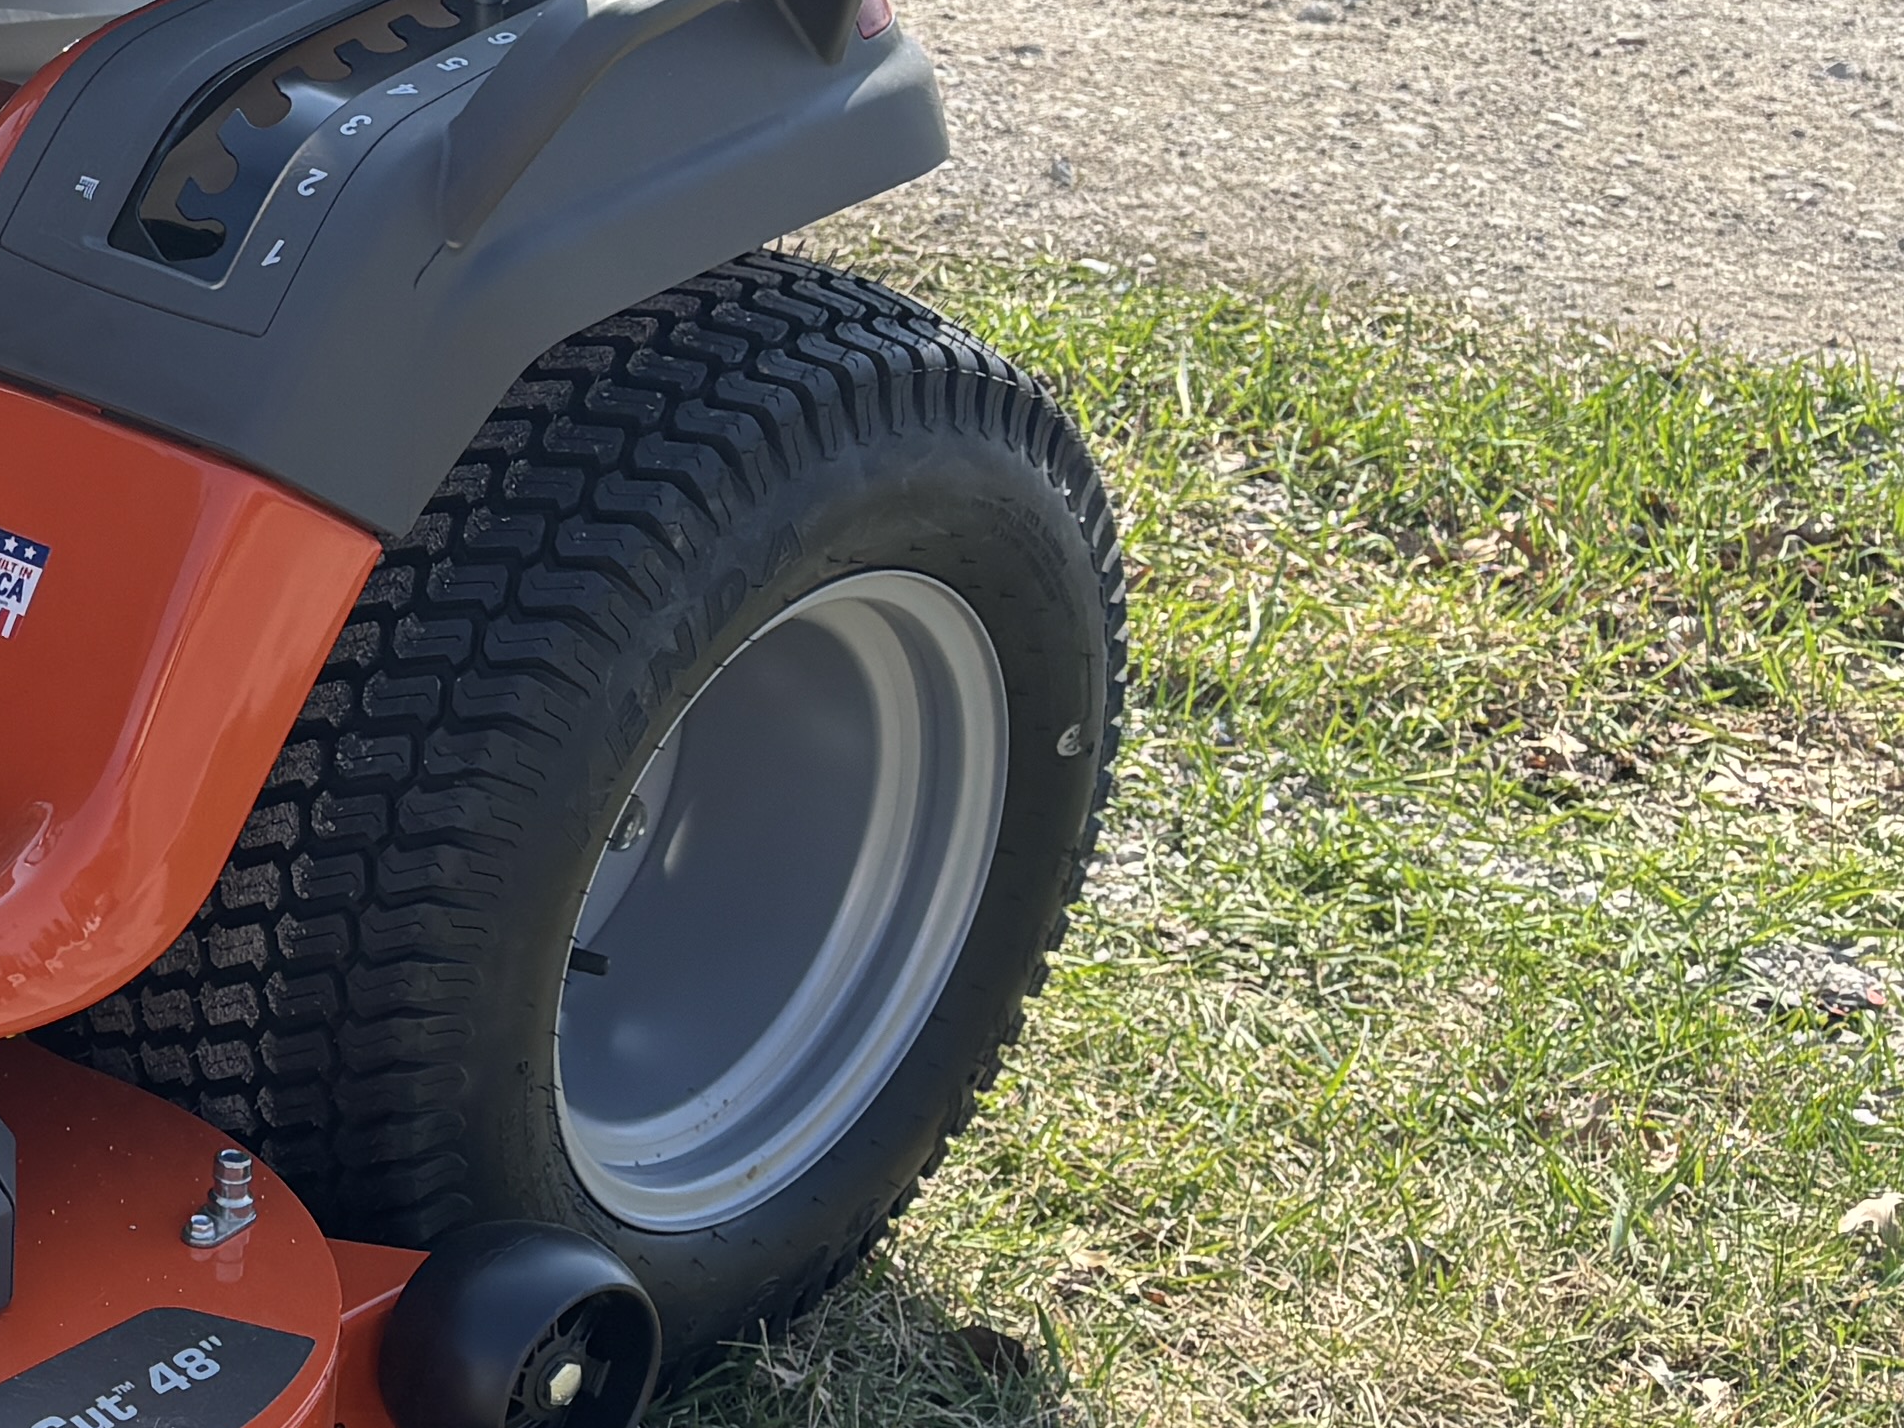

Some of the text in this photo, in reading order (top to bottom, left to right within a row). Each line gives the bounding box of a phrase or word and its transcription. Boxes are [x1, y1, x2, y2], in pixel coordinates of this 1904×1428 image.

[261, 239, 285, 266] 1
[297, 168, 328, 196] 2
[340, 115, 372, 136] 3
[386, 83, 419, 96] 4
[436, 56, 469, 71] 5
[19, 566, 34, 580] IN
[147, 1334, 224, 1397] 48"
